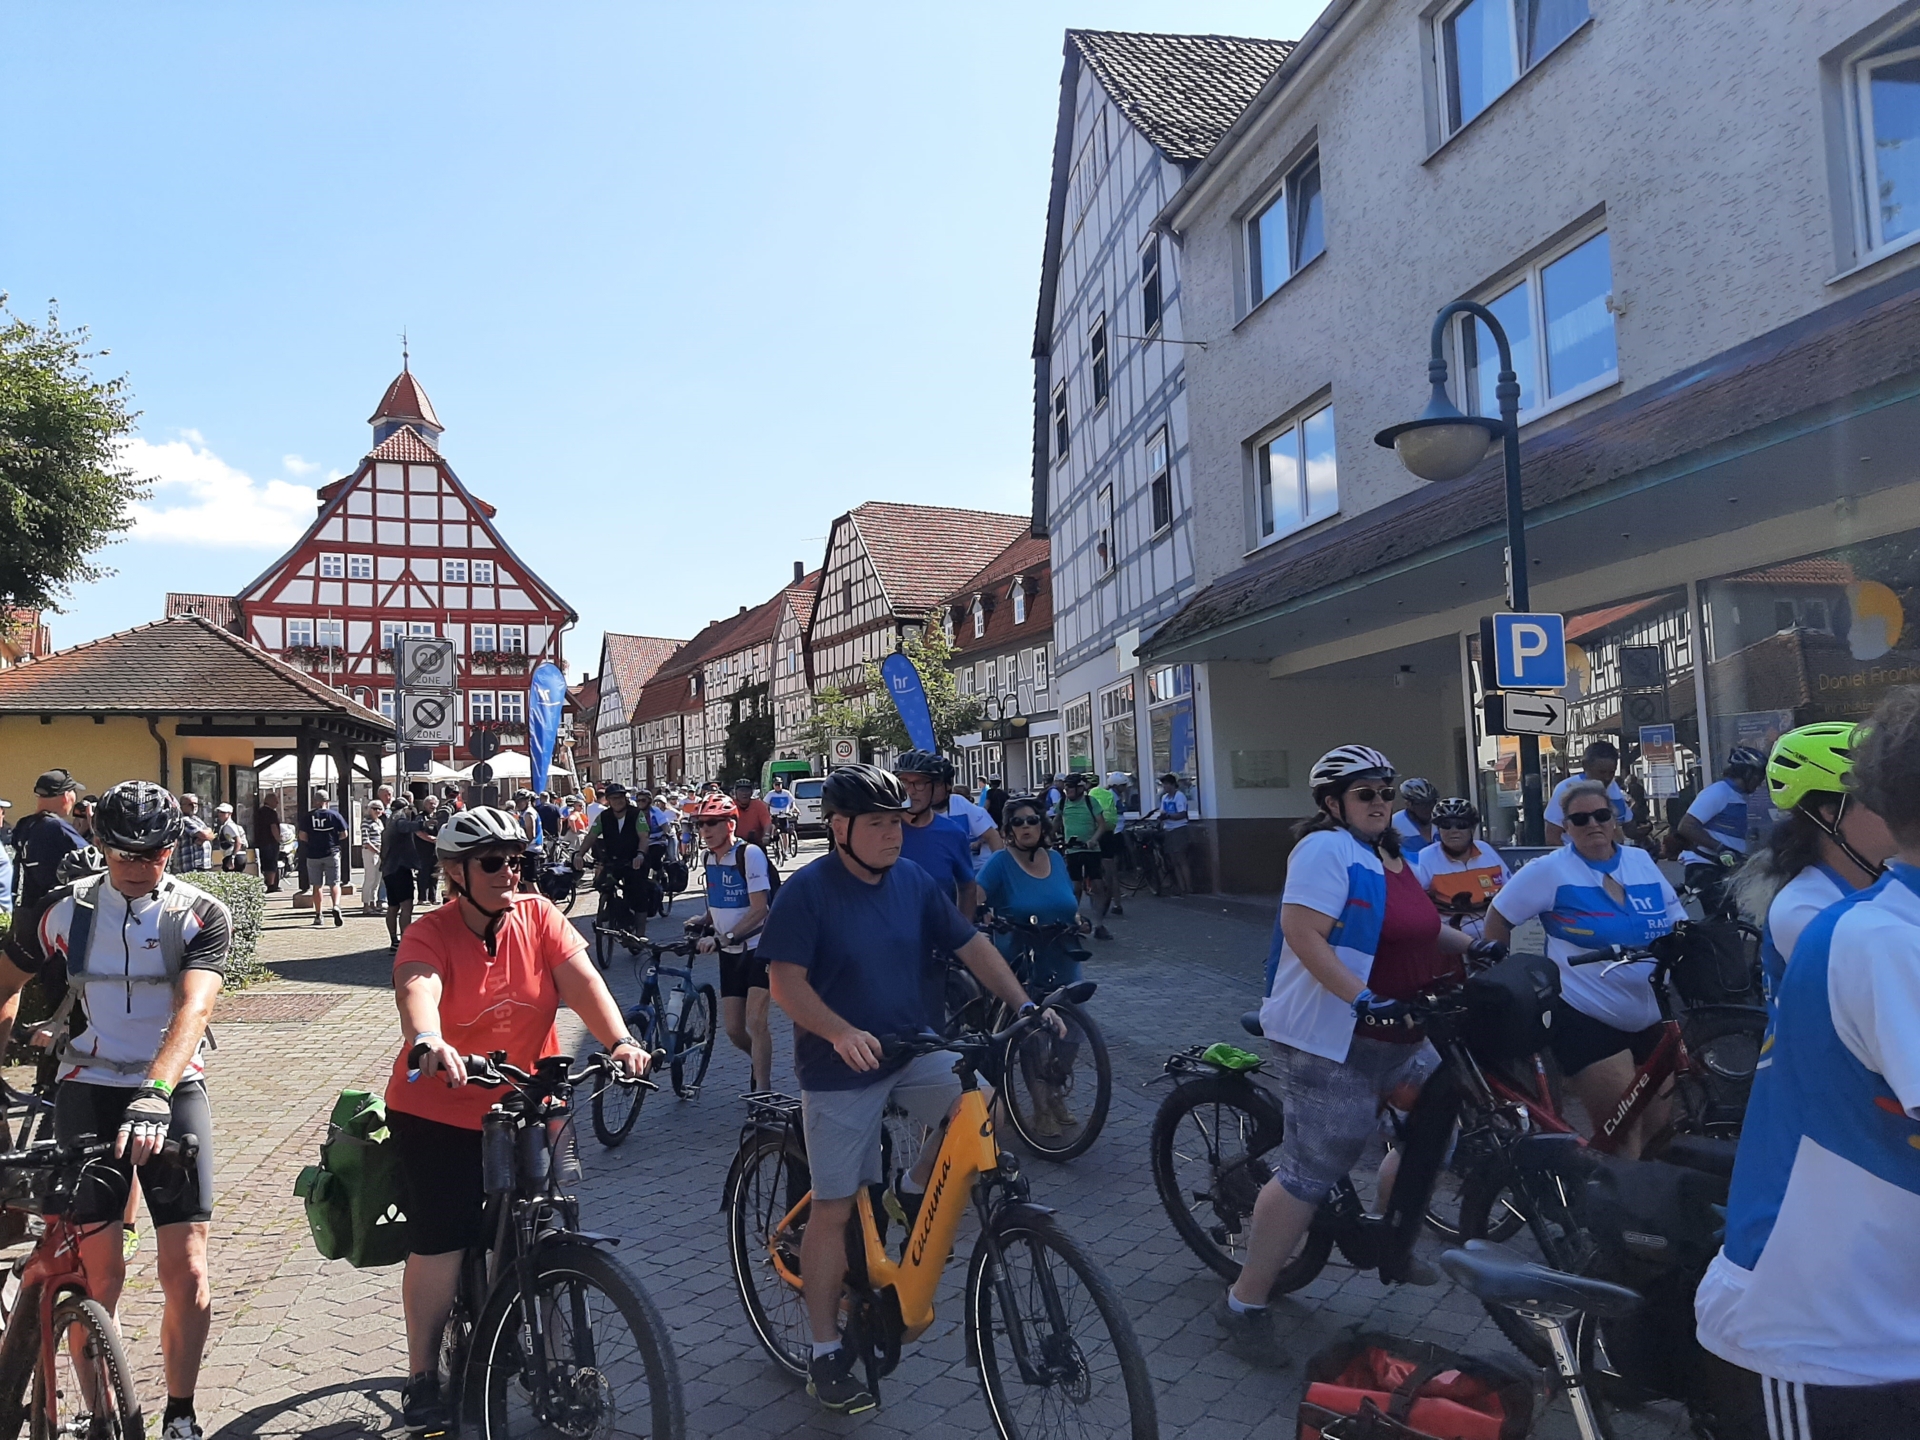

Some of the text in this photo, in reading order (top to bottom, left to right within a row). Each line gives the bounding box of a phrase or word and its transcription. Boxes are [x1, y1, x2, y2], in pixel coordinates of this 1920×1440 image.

[1511, 623, 1548, 677] P
[419, 652, 438, 666] 20
[416, 676, 441, 685] ZONE
[417, 730, 442, 739] ZONE
[839, 744, 850, 754] 20
[911, 1155, 951, 1267] Cucuma
